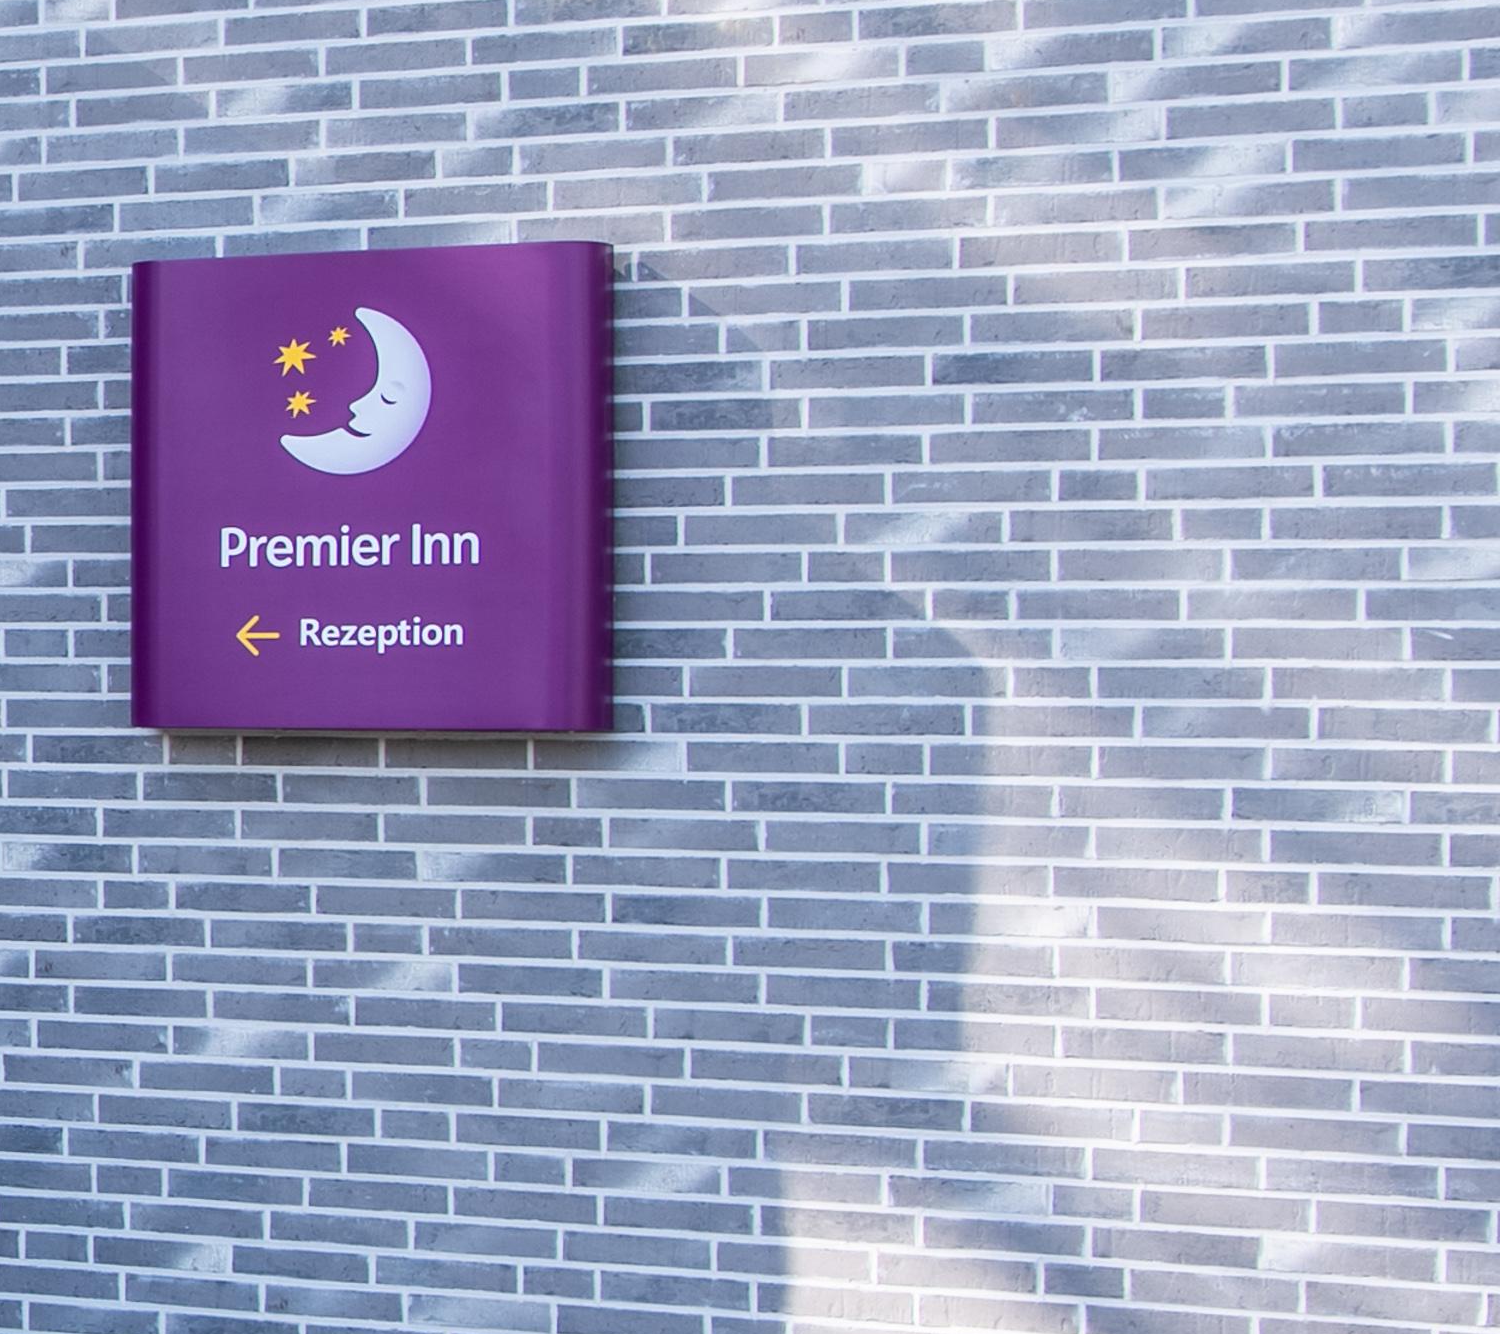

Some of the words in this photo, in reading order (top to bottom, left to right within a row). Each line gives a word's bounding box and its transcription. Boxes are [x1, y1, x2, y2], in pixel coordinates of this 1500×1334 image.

[220, 524, 400, 568] Premier
[411, 523, 480, 565] Inn
[300, 616, 464, 654] Rezeption
